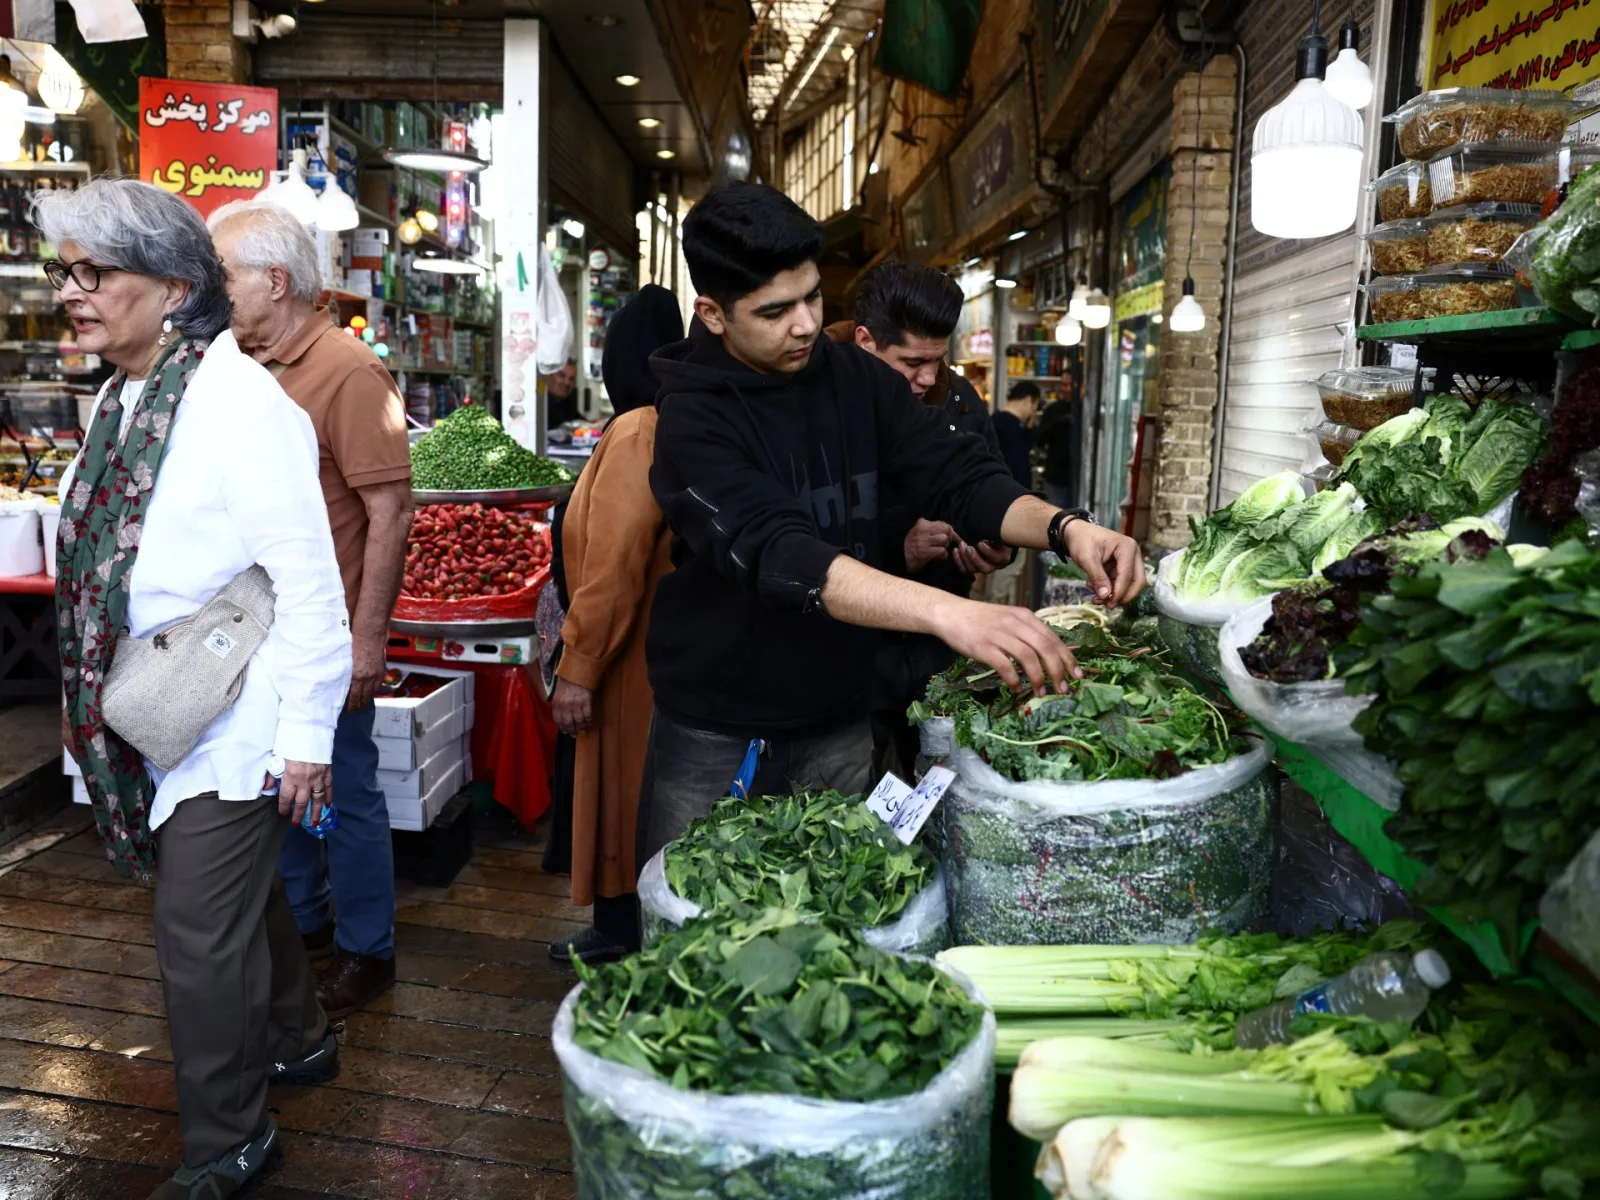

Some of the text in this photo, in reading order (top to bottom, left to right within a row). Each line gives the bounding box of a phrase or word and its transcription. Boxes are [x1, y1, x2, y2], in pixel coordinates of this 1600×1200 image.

[145, 92, 272, 135] مرکز پخش
[152, 155, 264, 197] سمنوی
